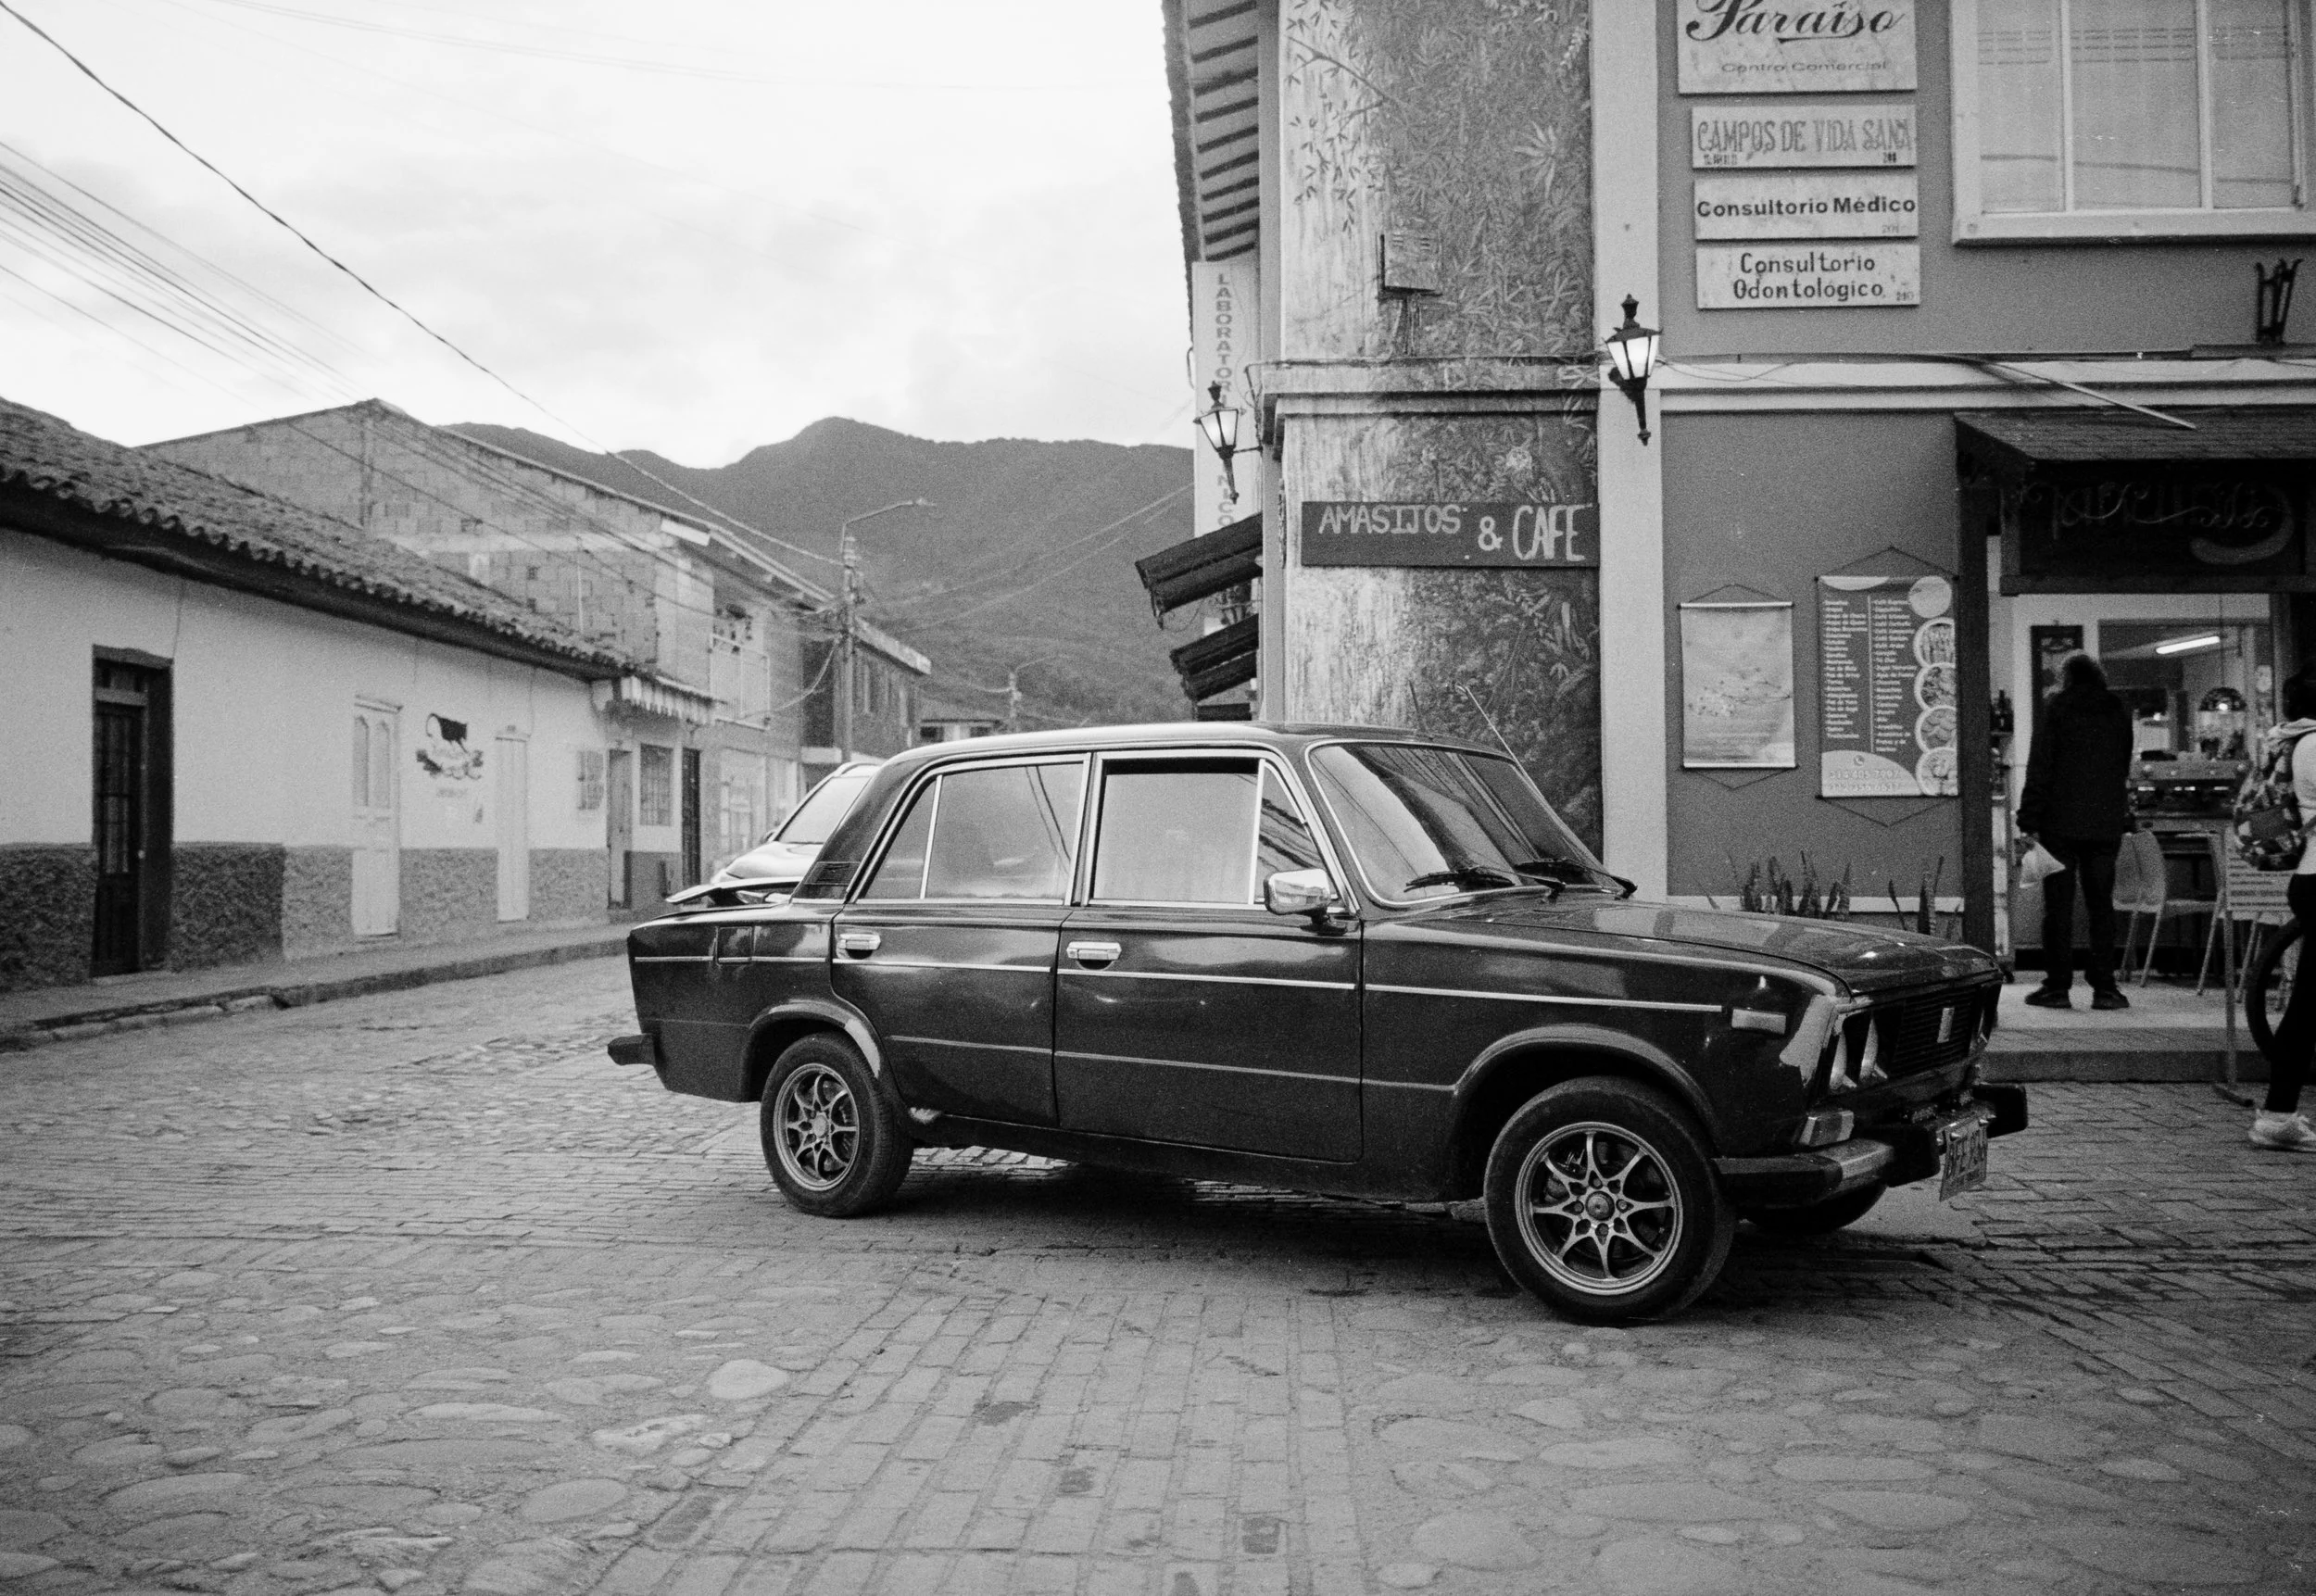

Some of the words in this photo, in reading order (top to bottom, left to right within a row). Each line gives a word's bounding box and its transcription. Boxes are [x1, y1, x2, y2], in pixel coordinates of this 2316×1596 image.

[1721, 61, 1786, 73] Centro
[1792, 60, 1887, 72] Comercial
[1697, 119, 1776, 153] CAMPOS
[1781, 120, 1806, 152] DE
[1812, 119, 1857, 152] VIDA
[1696, 198, 1828, 218] Consultorio
[1832, 195, 1916, 214] Médico
[1740, 251, 1876, 274] Consultorio
[1215, 273, 1233, 406] LABORATORI
[1318, 504, 1461, 534] AMASIJOS
[1478, 515, 1504, 551] &
